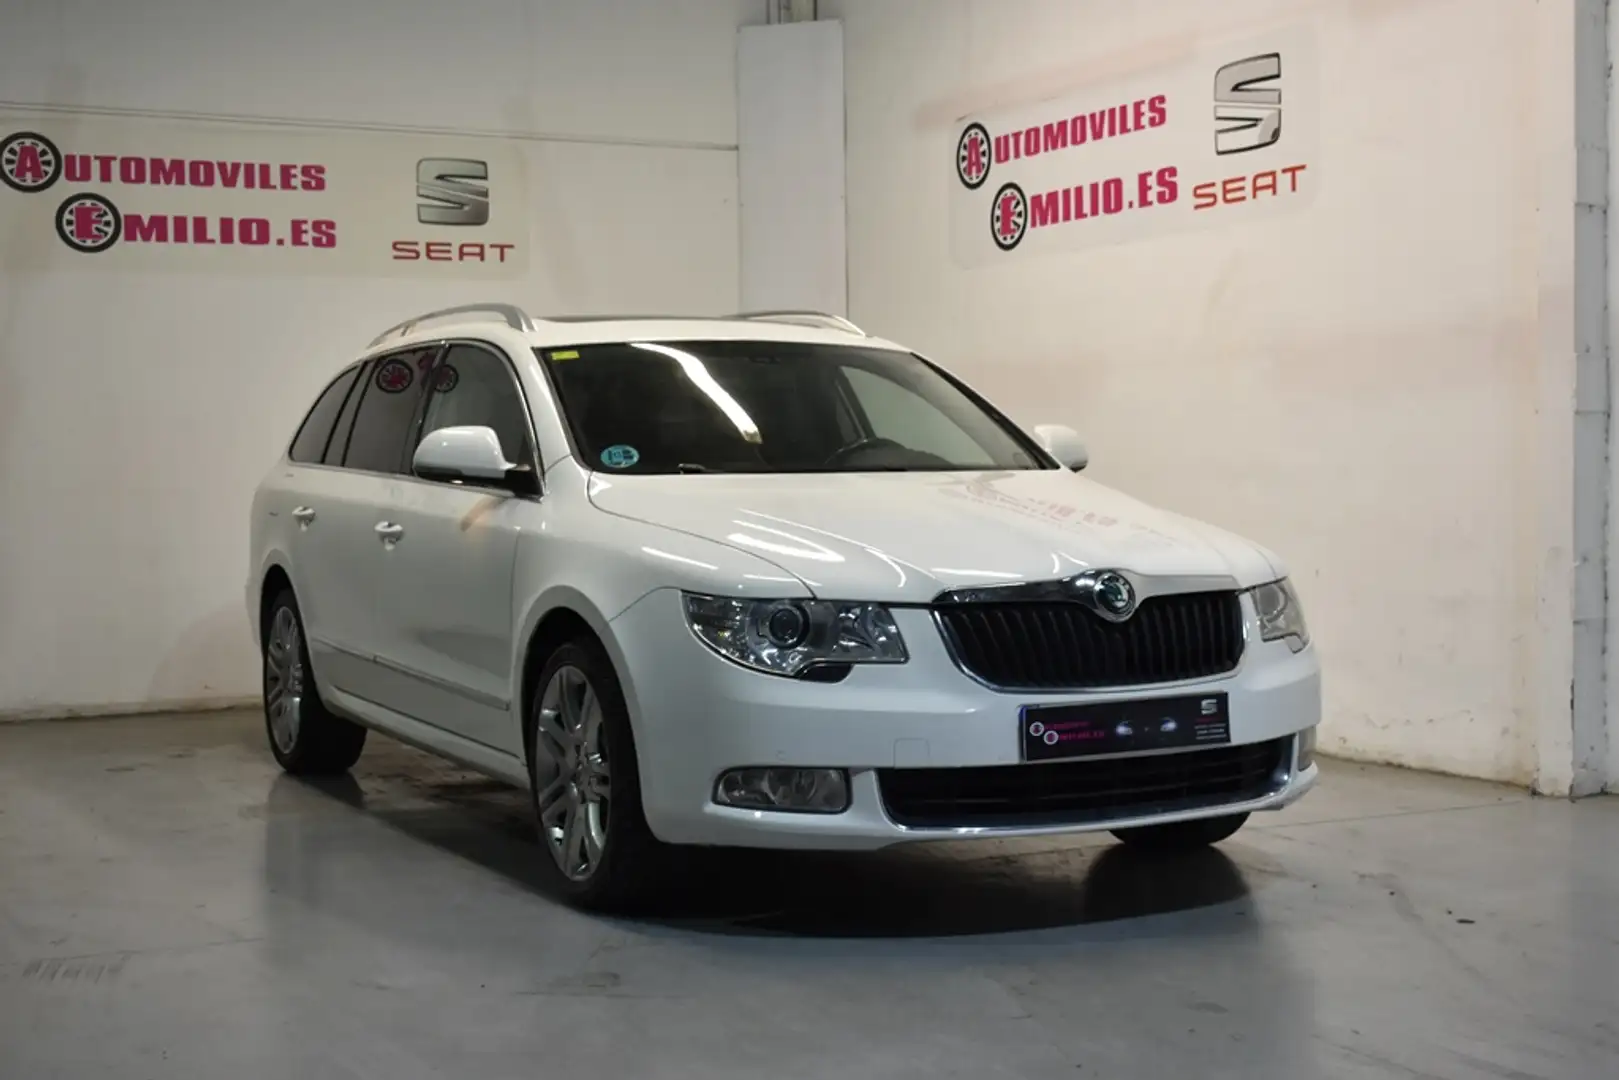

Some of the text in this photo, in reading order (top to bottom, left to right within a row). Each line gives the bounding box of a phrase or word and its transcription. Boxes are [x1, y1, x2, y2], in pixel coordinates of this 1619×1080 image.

[967, 95, 1169, 178] AUTOMOVILES
[14, 145, 328, 192] AUTOMOVILES
[1193, 164, 1307, 211] SEAT
[1000, 166, 1179, 238] EMILIO.ES
[75, 205, 338, 250] EMILIO.ES
[392, 241, 515, 263] SEAT
